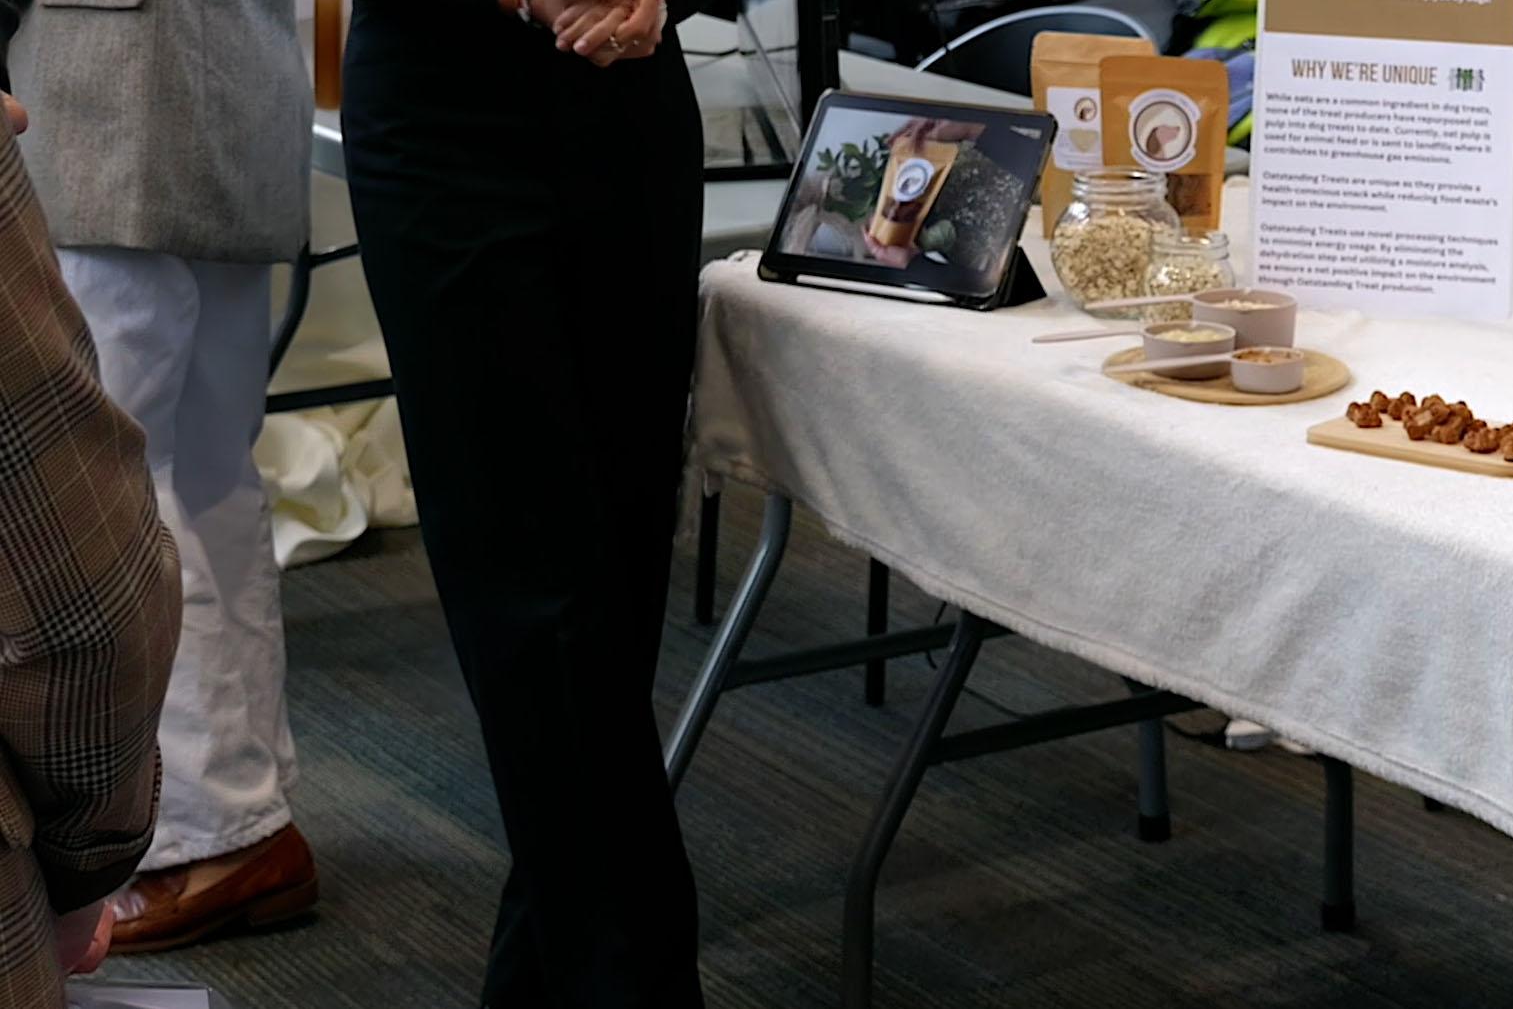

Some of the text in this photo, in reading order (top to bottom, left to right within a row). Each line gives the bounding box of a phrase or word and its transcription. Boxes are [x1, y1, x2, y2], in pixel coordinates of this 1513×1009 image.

[1291, 58, 1436, 86] WHY WE'RE UNIQUE
